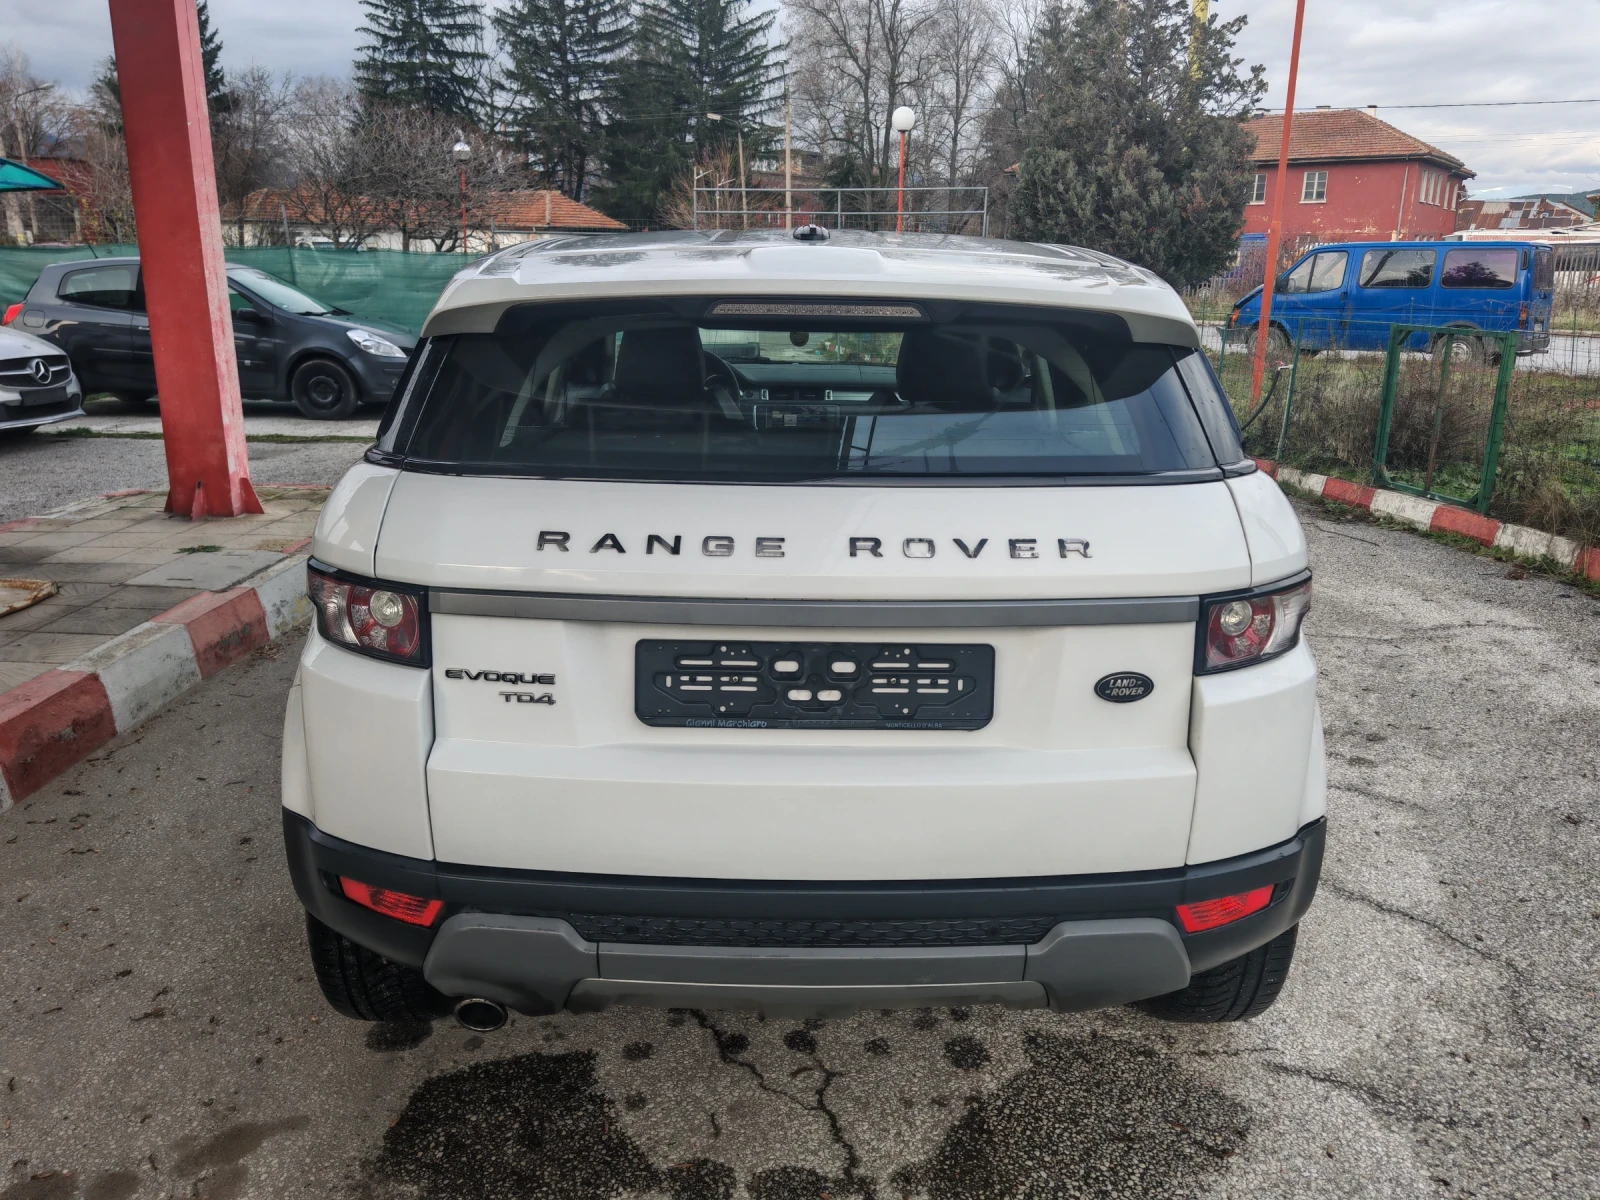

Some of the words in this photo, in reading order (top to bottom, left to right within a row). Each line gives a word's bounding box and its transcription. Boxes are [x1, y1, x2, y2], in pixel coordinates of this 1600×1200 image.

[536, 530, 786, 558] RANGE
[849, 537, 1093, 559] ROVER
[445, 668, 555, 685] EVOQUE
[1109, 678, 1136, 688] LAND
[498, 691, 556, 705] TD4
[1111, 687, 1144, 696] ROVER
